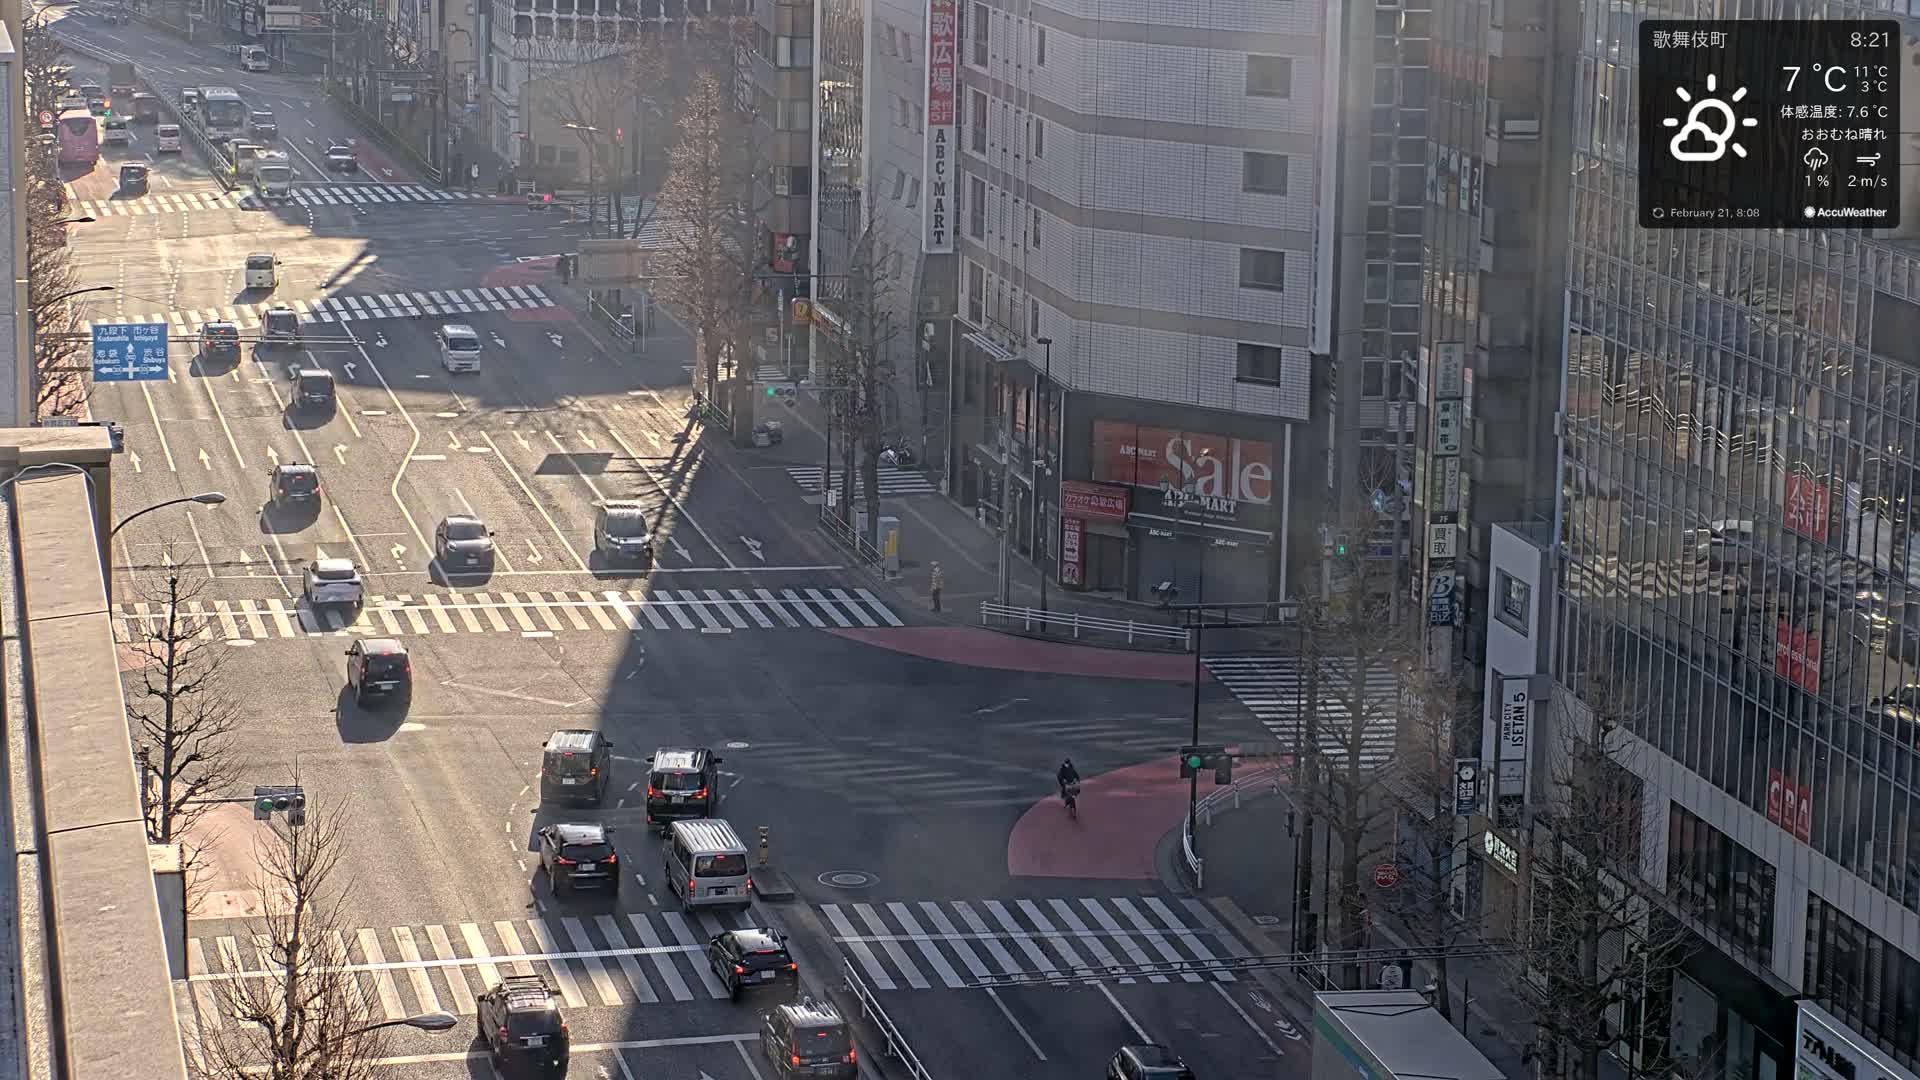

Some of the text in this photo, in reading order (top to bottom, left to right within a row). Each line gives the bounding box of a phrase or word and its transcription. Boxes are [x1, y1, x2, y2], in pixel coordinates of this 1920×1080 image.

[99, 326, 128, 335] 九段下
[1166, 438, 1272, 503] Sale
[1433, 527, 1447, 555] 買取
[1504, 703, 1512, 741] PARK CITY
[1512, 692, 1526, 747] ISETAN 5
[1769, 782, 1809, 815] CPA
